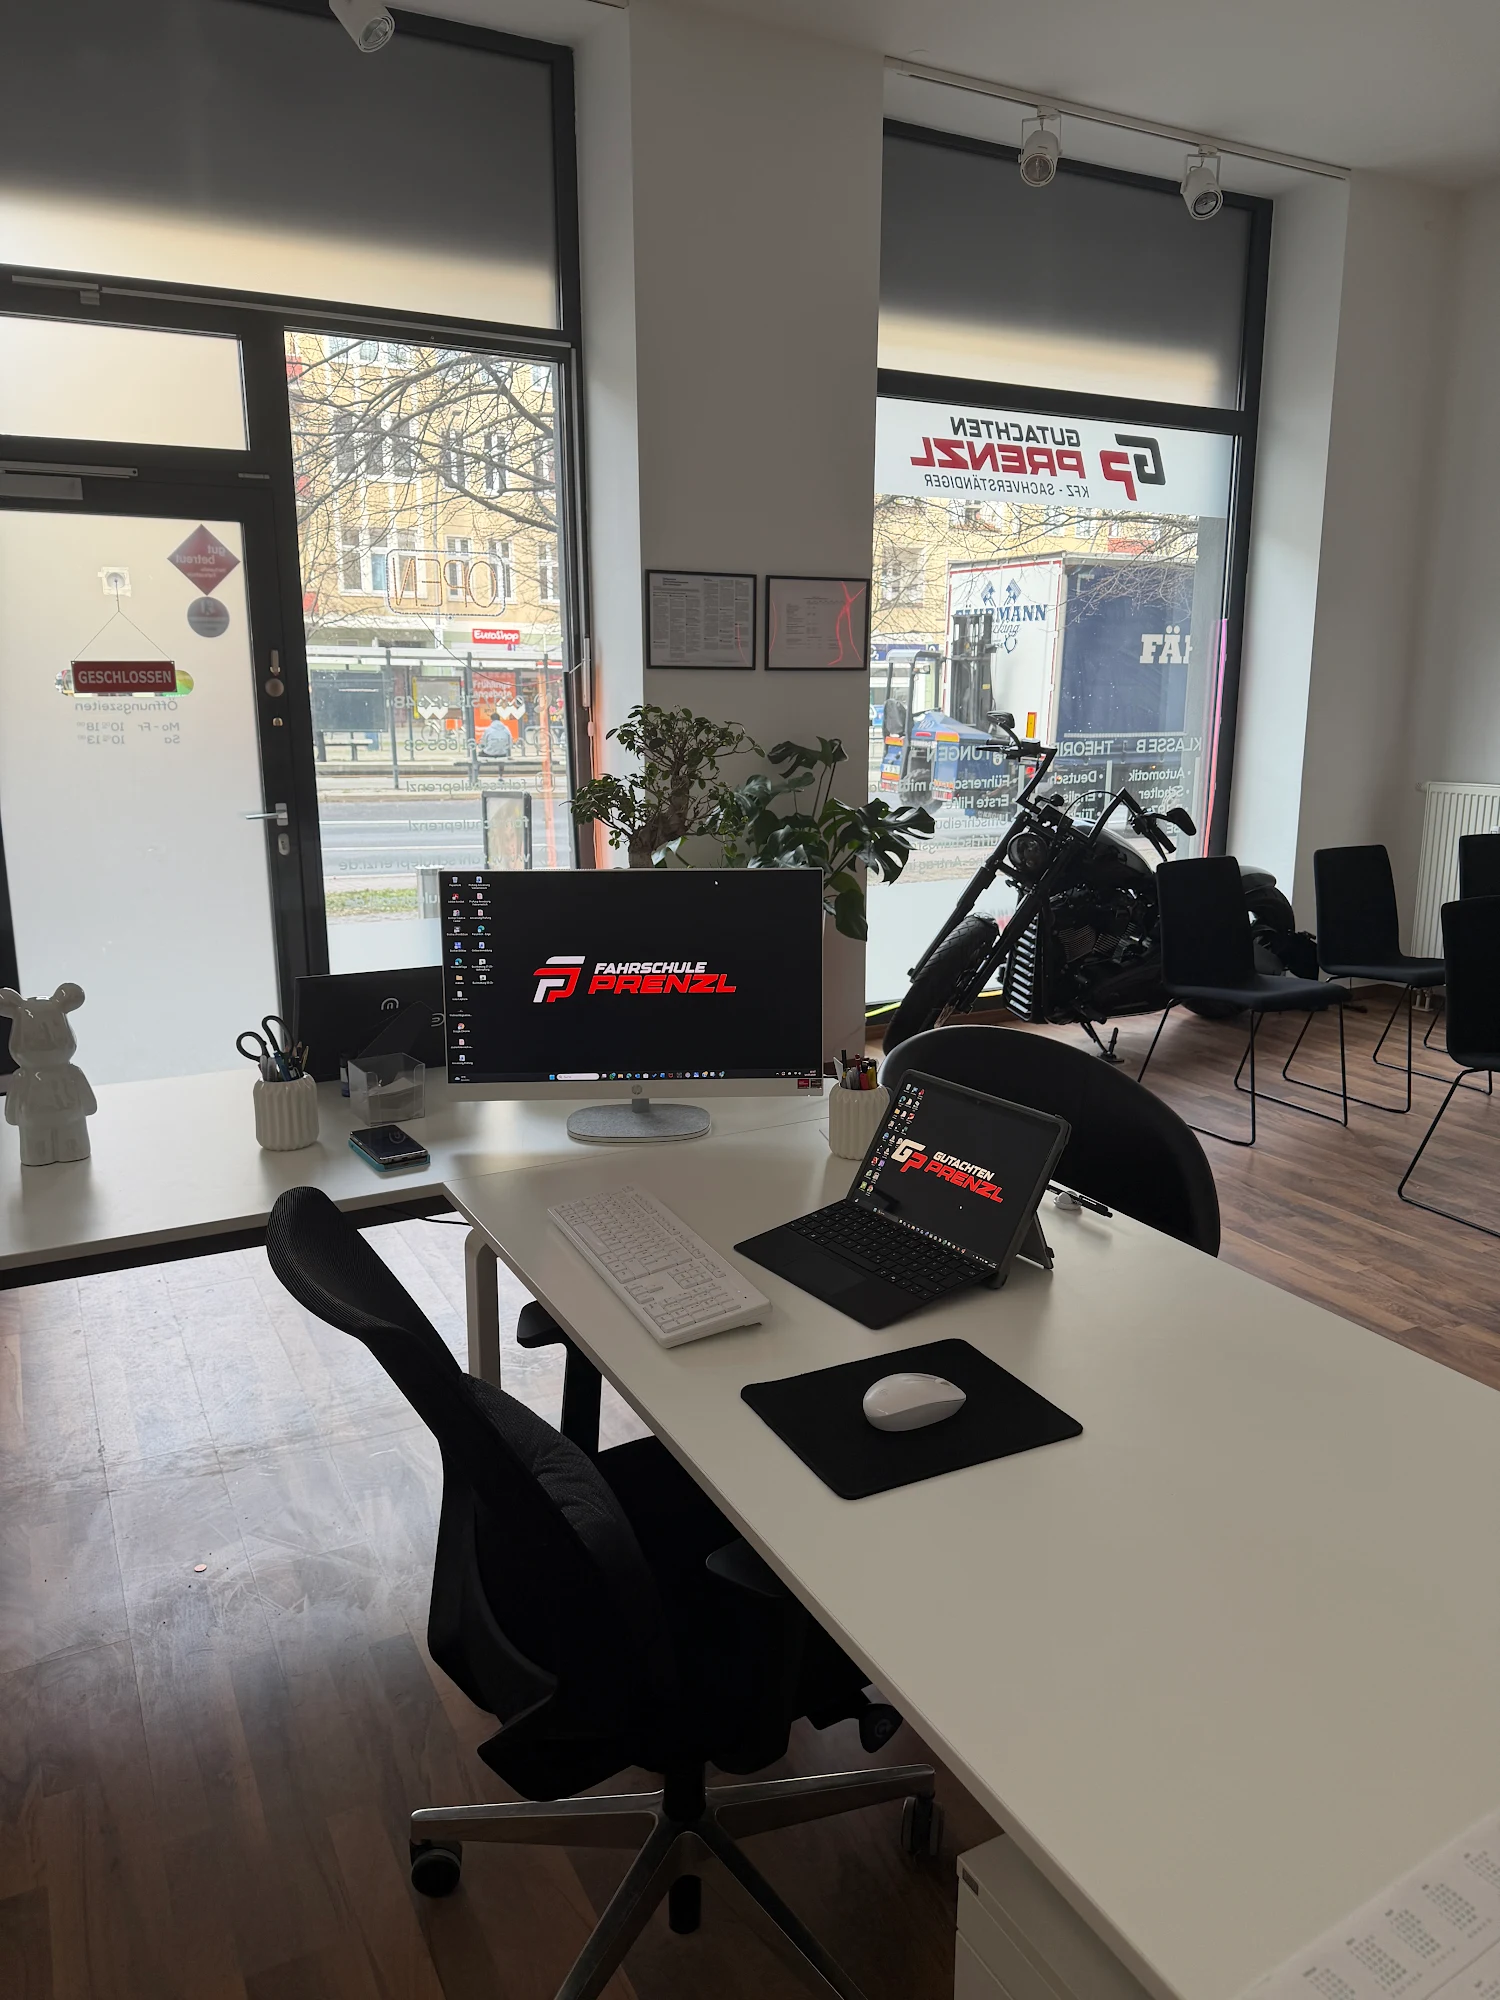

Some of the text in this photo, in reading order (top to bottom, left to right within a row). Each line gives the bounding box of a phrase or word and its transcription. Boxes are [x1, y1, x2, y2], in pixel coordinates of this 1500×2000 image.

[474, 630, 519, 642] EuroShop
[78, 670, 172, 684] GESCHLOSSEN
[594, 961, 708, 975] FAHRSCHULE
[587, 974, 737, 995] PRENZL
[932, 1151, 996, 1181] GUTACHTEN
[924, 1160, 1004, 1203] PRENZL
